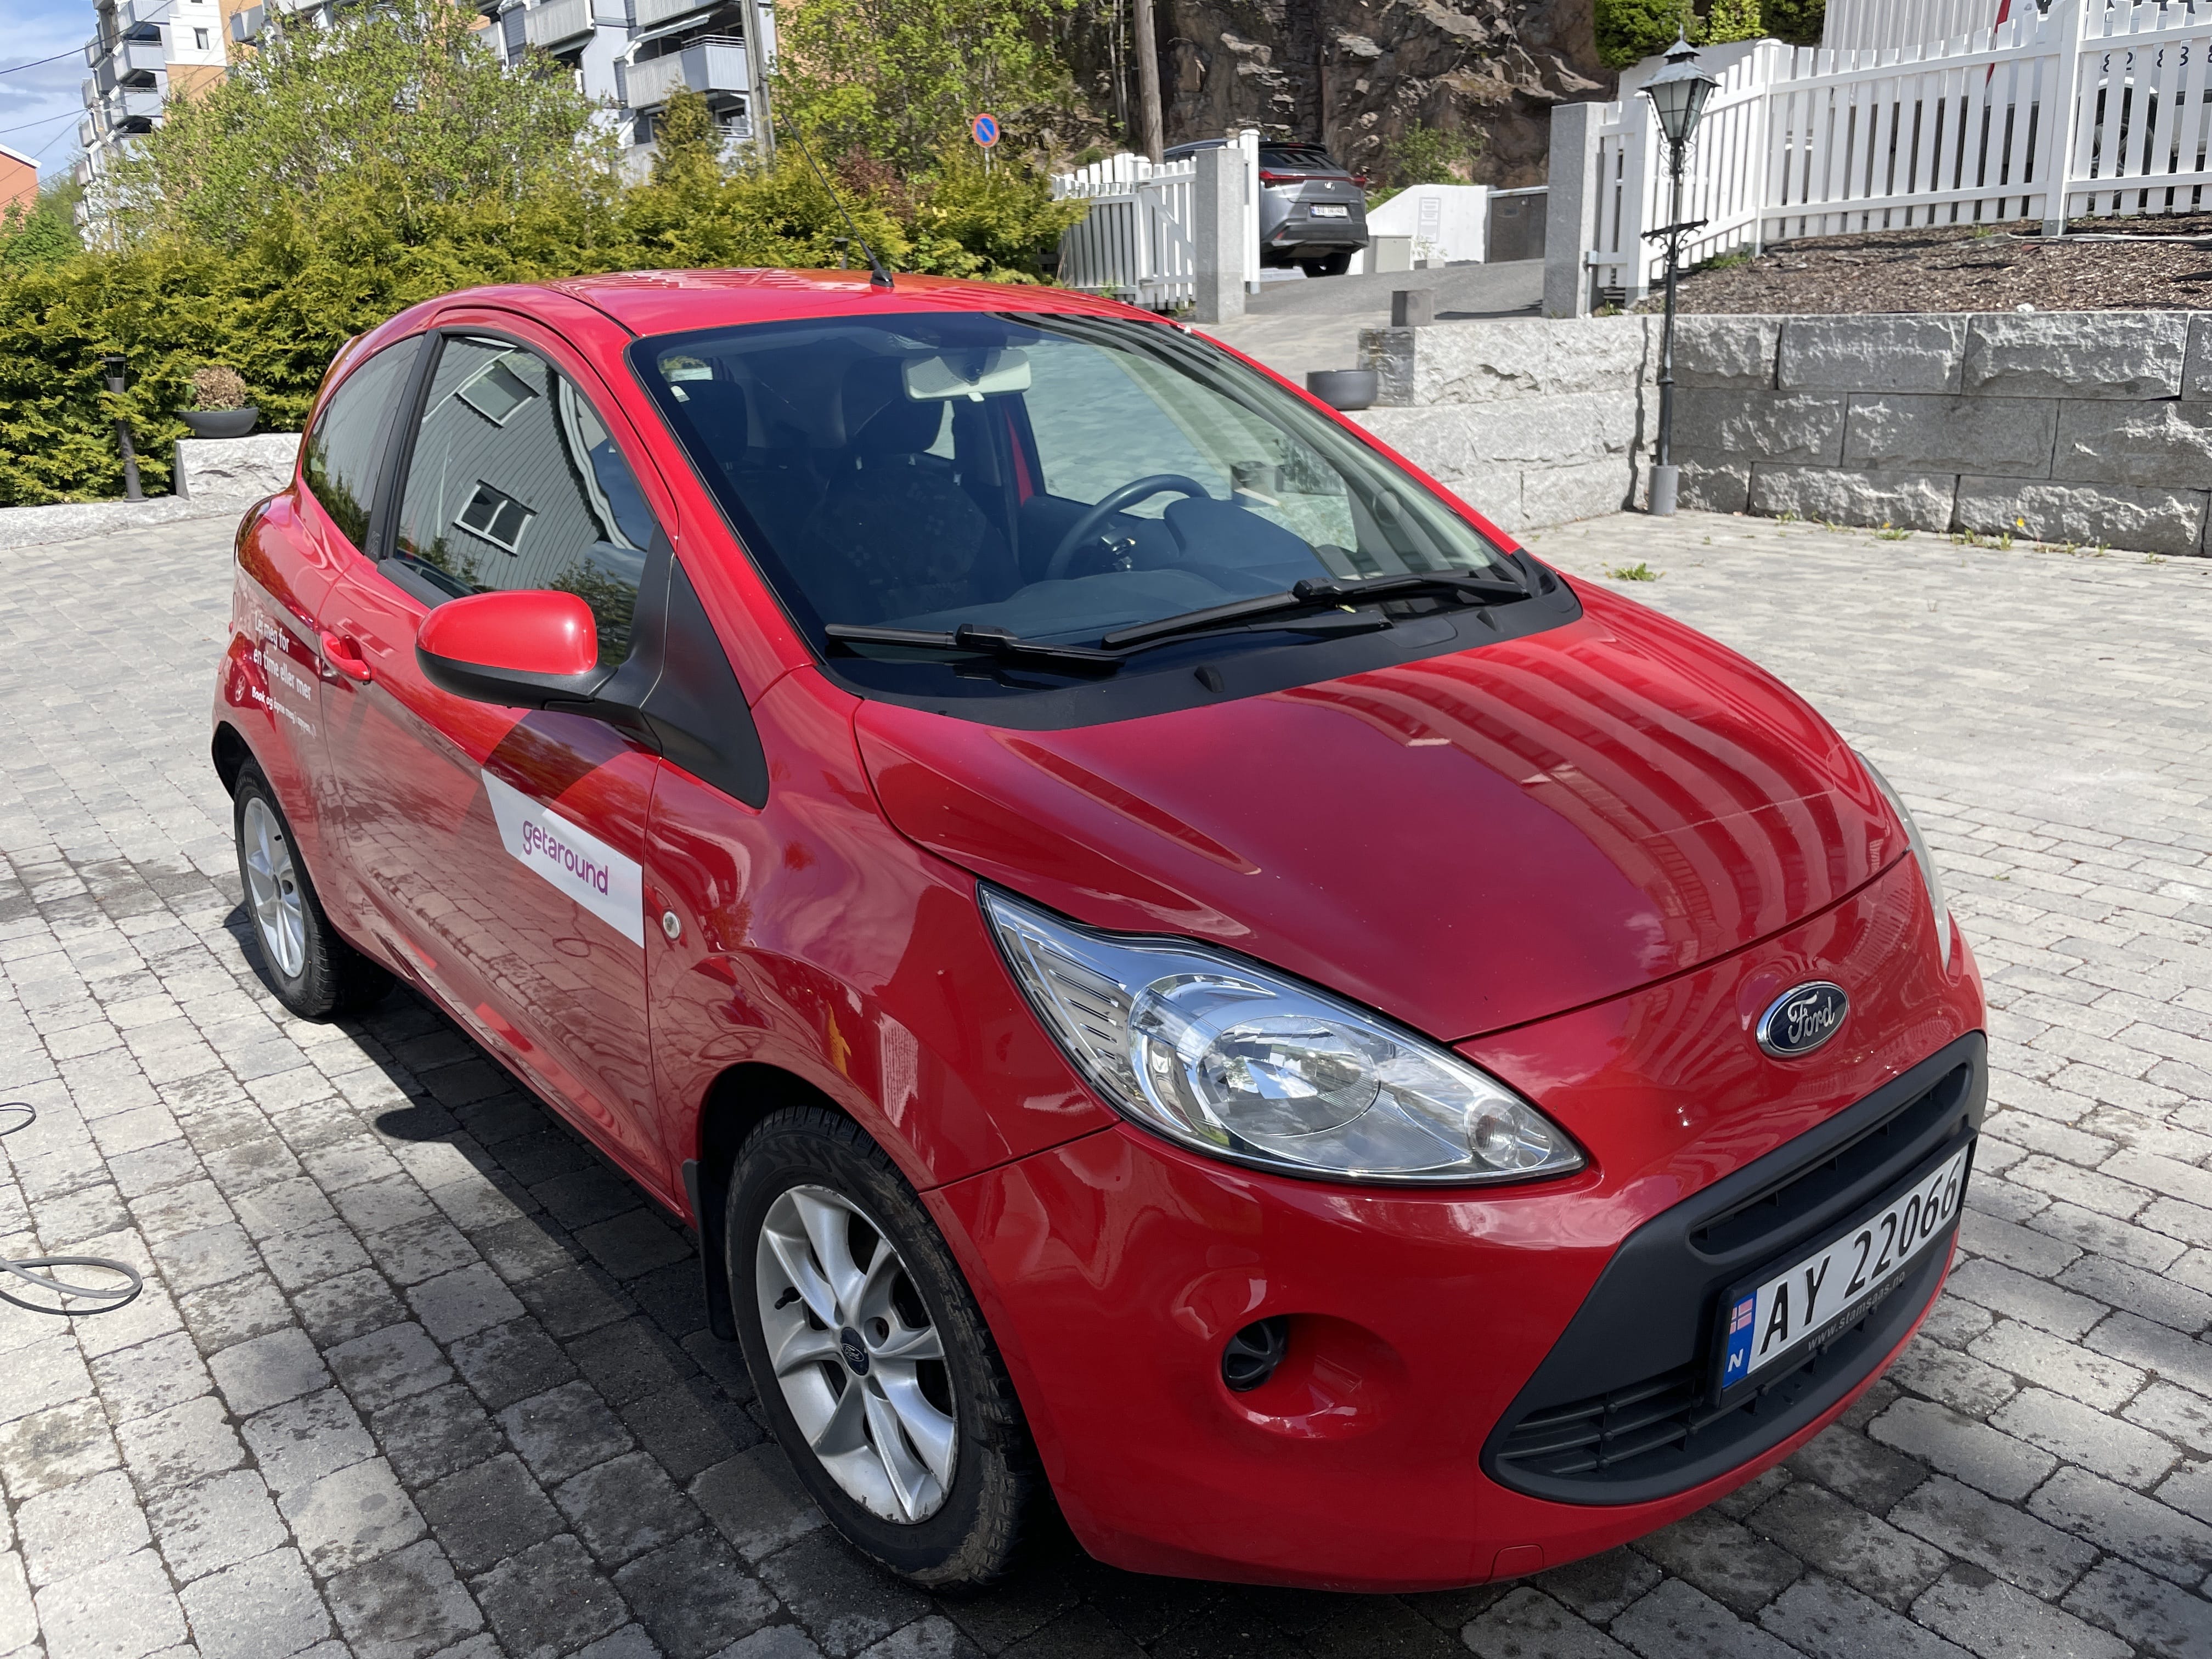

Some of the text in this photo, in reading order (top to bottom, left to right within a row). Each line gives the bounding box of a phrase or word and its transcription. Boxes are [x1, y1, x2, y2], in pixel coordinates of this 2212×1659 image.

[264, 623, 278, 651] meg
[279, 627, 290, 653] for
[251, 686, 265, 703] Book
[266, 696, 273, 710] og
[253, 648, 311, 701] en time eller mer
[522, 820, 609, 896] getaround
[1787, 990, 1835, 1044] Ford
[1759, 1153, 1962, 1356] AY 22066
[1808, 1271, 1905, 1351] www.stamsaas.no
[1727, 1348, 1743, 1373] N
